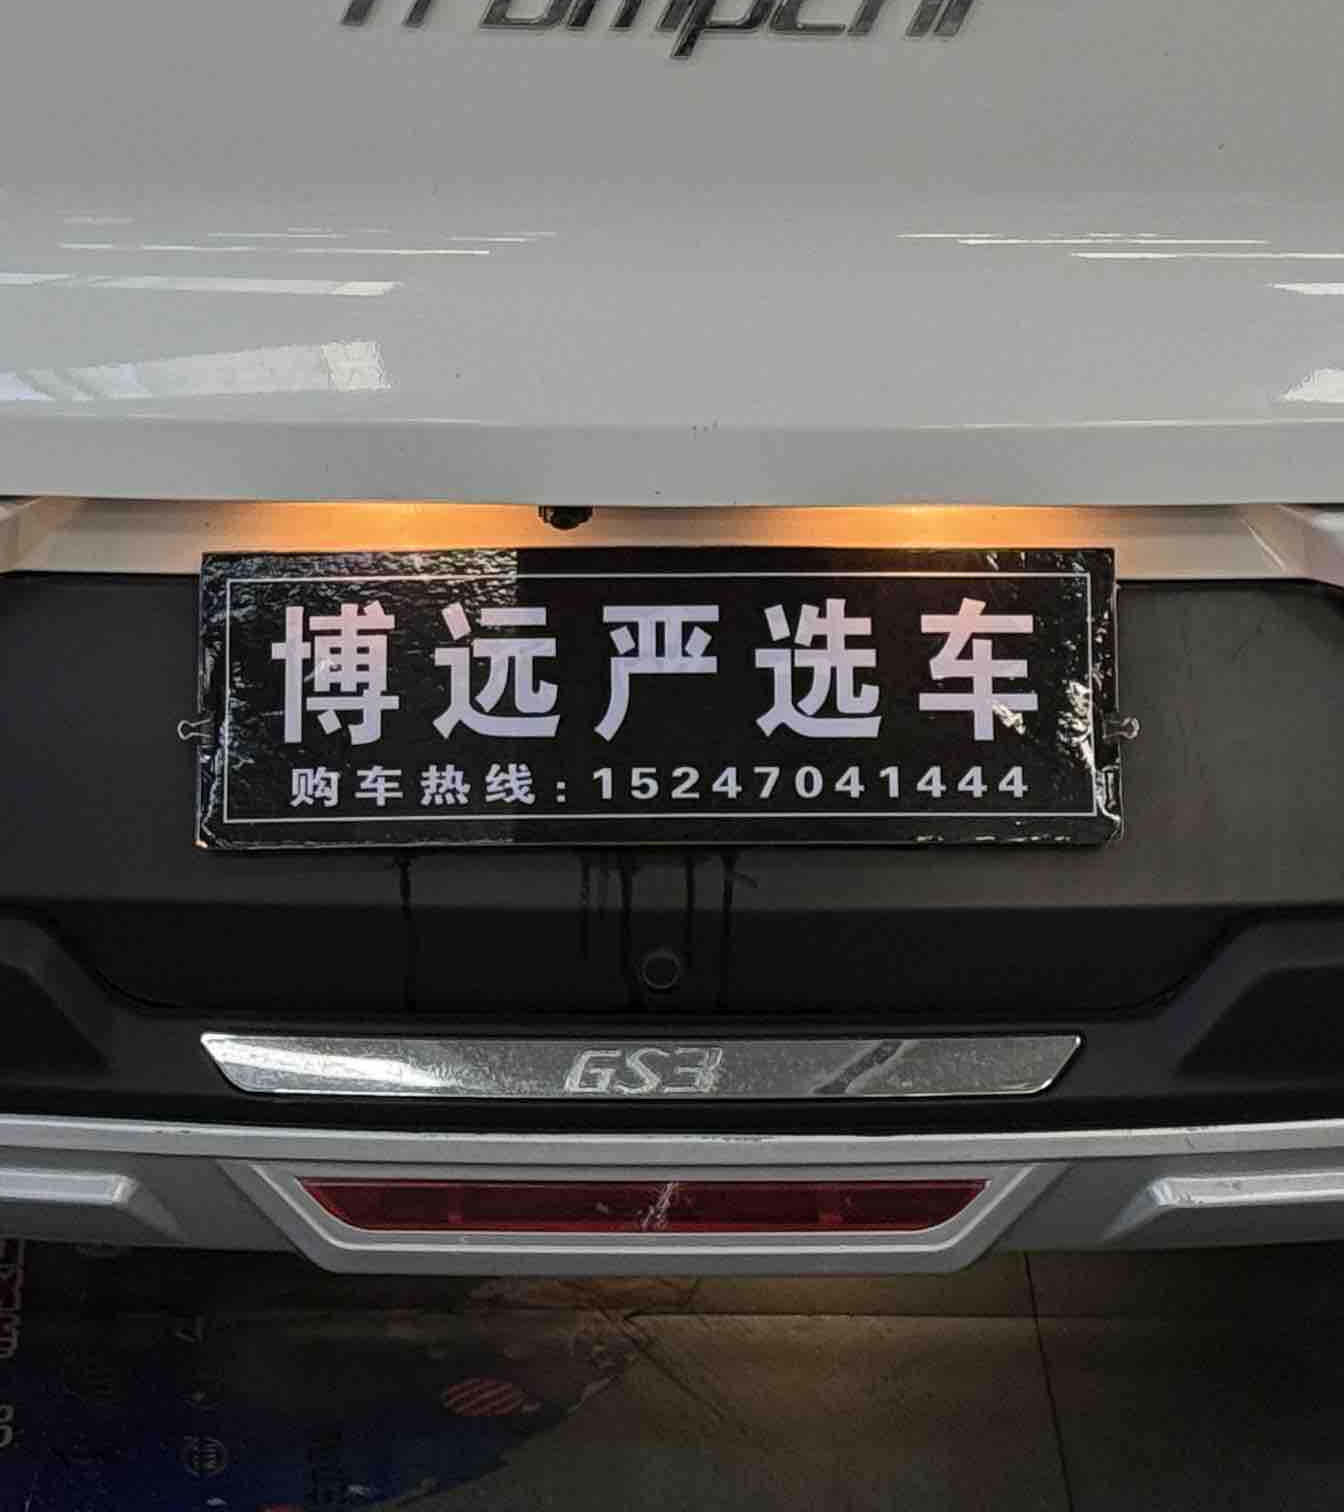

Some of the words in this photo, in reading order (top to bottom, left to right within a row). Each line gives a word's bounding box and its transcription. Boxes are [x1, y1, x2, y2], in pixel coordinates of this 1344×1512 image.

[271, 597, 1039, 744] 博远严选车
[562, 1047, 725, 1094] GS3
